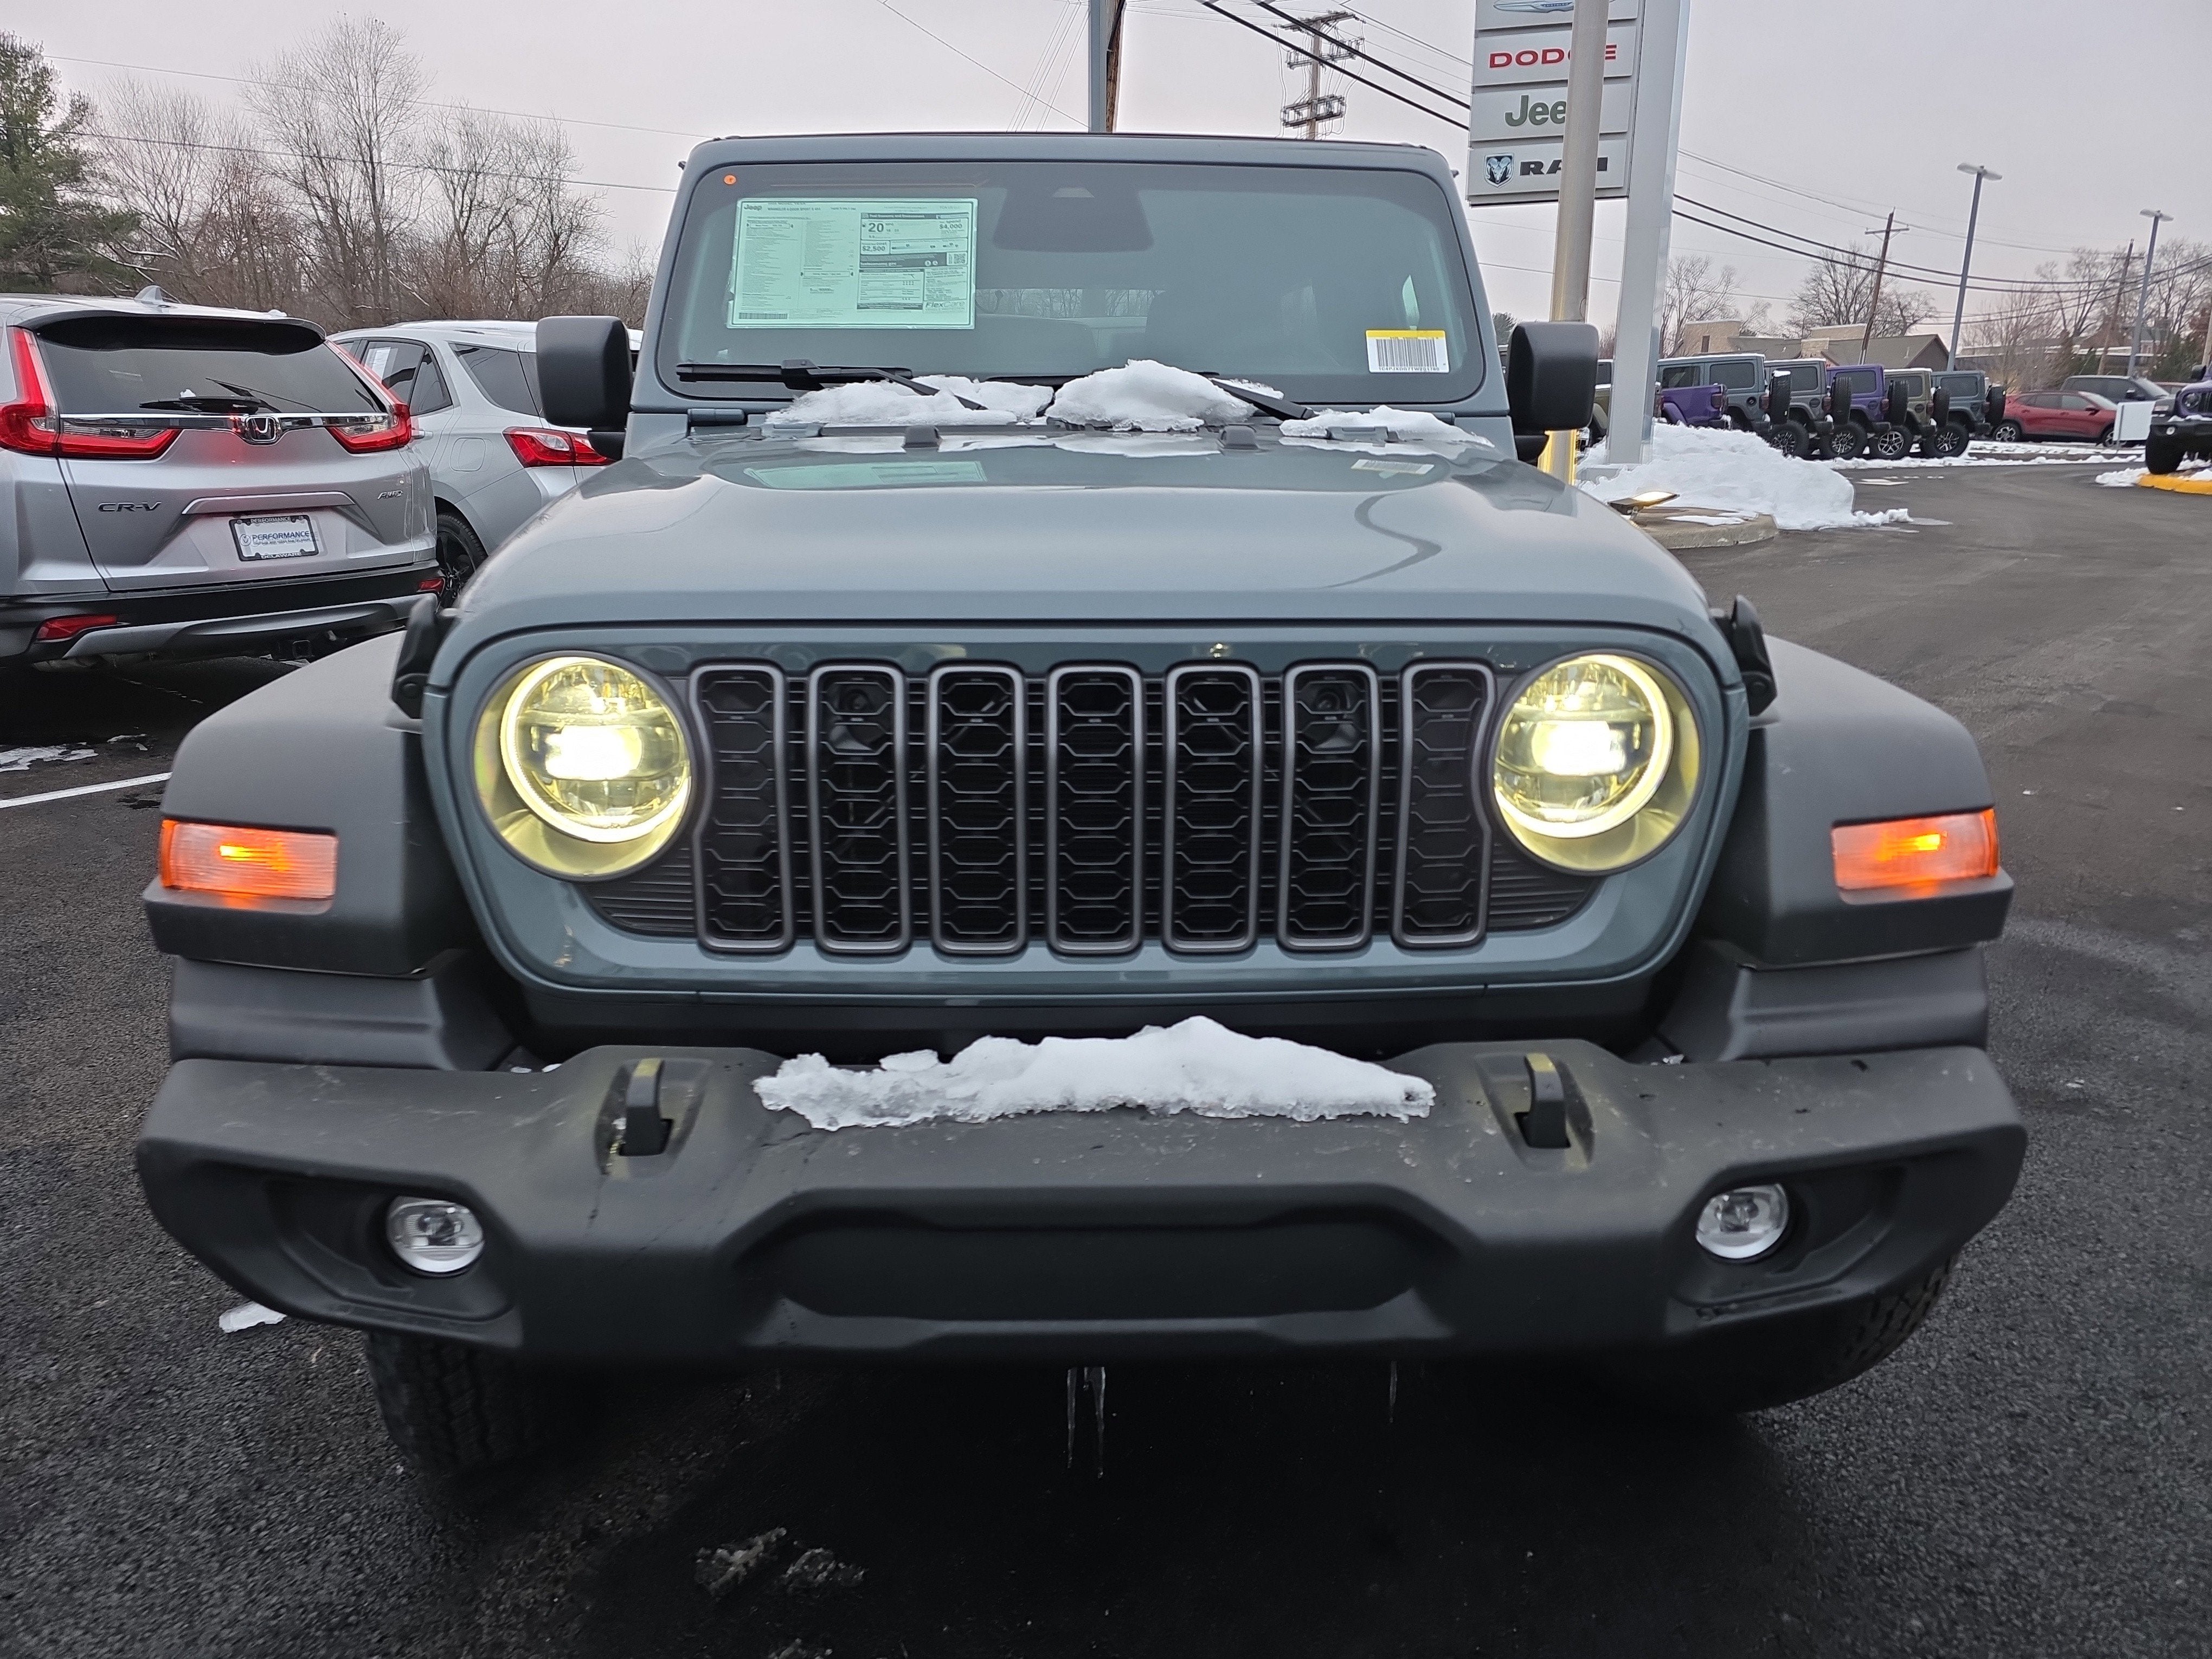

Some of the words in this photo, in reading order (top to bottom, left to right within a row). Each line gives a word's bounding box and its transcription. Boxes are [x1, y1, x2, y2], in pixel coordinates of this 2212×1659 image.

[1489, 44, 1617, 68] DODE
[1504, 94, 1566, 127] Jee
[868, 223, 884, 233] 20
[98, 502, 162, 512] CR-V
[252, 530, 310, 541] PERFORMANCE
